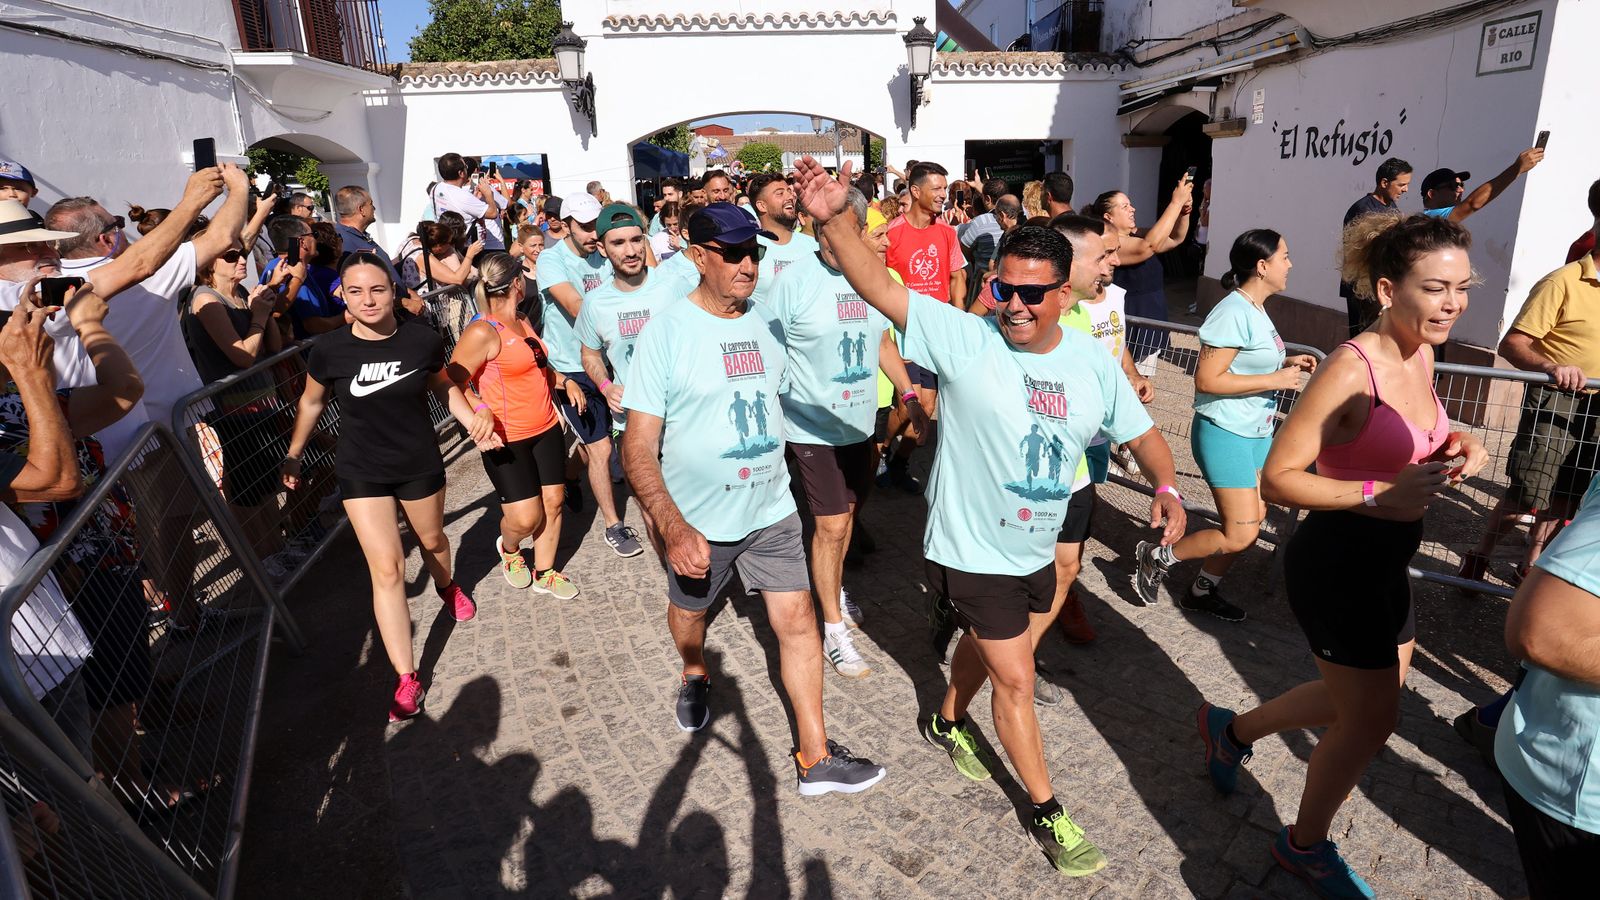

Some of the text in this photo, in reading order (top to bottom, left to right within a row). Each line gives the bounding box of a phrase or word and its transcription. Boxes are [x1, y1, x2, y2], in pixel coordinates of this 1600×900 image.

[1499, 23, 1536, 39] CALLE
[1500, 50, 1522, 64] RIO
[837, 302, 868, 318] BARRO
[1097, 321, 1110, 330] SOY
[720, 342, 727, 352] V
[728, 341, 752, 352] carrera
[357, 360, 402, 382] NIKE
[723, 352, 765, 375] BARRO
[1054, 381, 1065, 393] del
